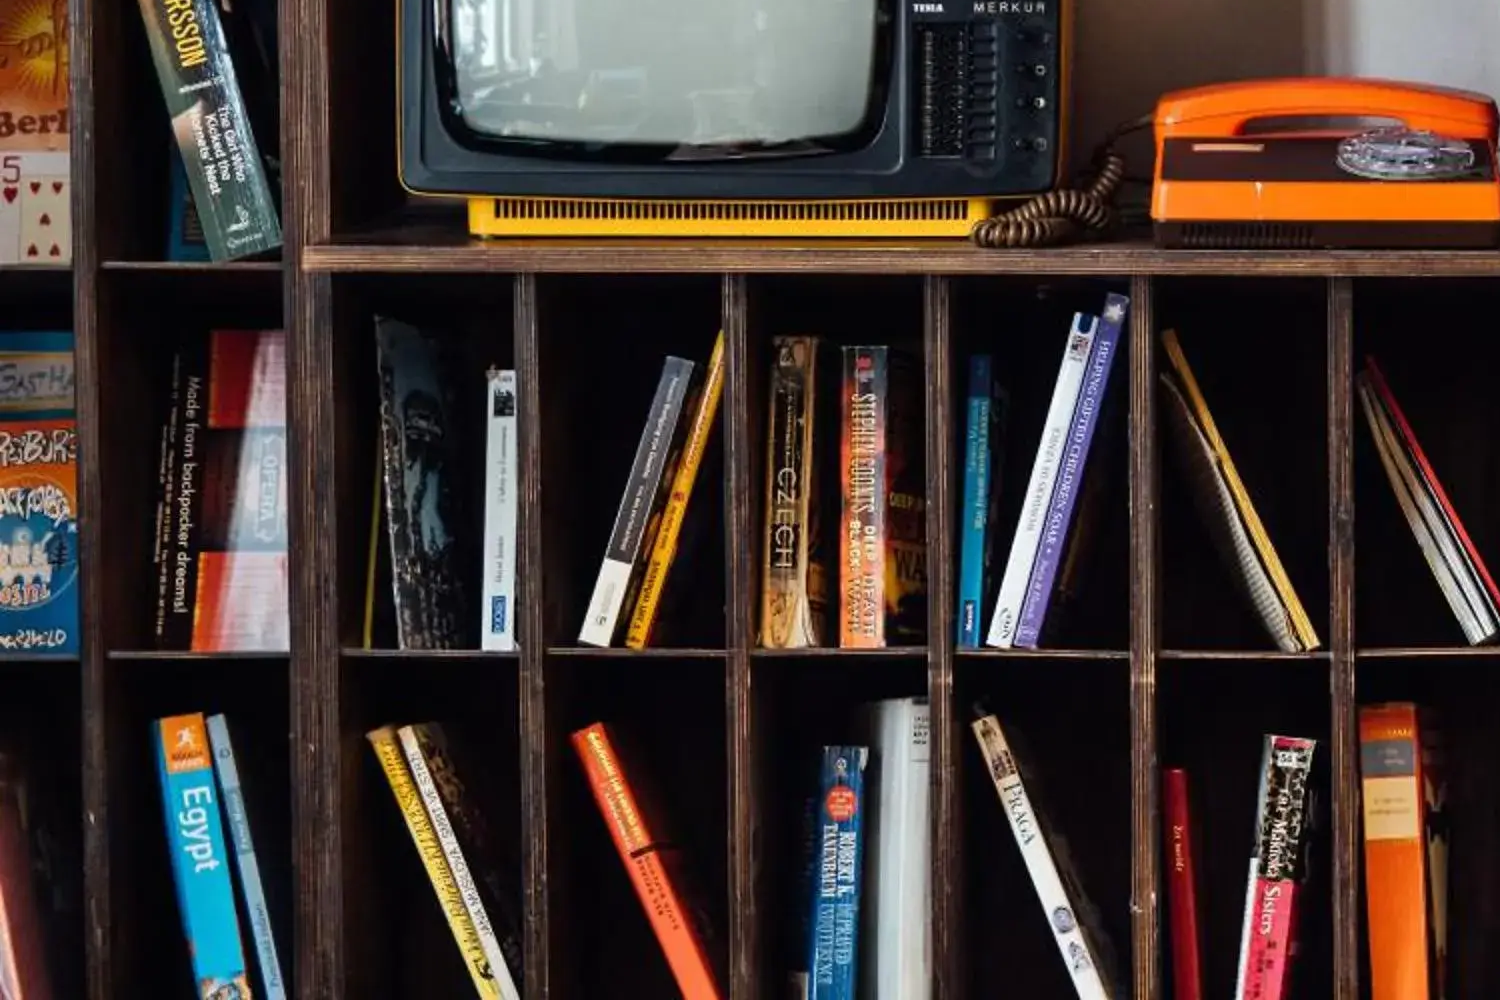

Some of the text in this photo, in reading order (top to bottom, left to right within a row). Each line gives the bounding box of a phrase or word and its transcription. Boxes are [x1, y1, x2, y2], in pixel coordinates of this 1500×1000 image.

[973, 1, 1046, 14] MERKUR
[205, 111, 226, 158] Kicked
[3, 156, 20, 183] 5
[1085, 339, 1112, 397] HELPING
[852, 394, 875, 450] STEPHEN
[1071, 396, 1096, 443] GIFTED
[173, 375, 201, 614] Made from backpacker dreams!
[1052, 443, 1082, 509] CHILDREN
[774, 467, 797, 568] CZECH
[179, 785, 220, 873] Egypt
[1003, 781, 1036, 845] PRAGA
[1260, 885, 1280, 936] Sisters
